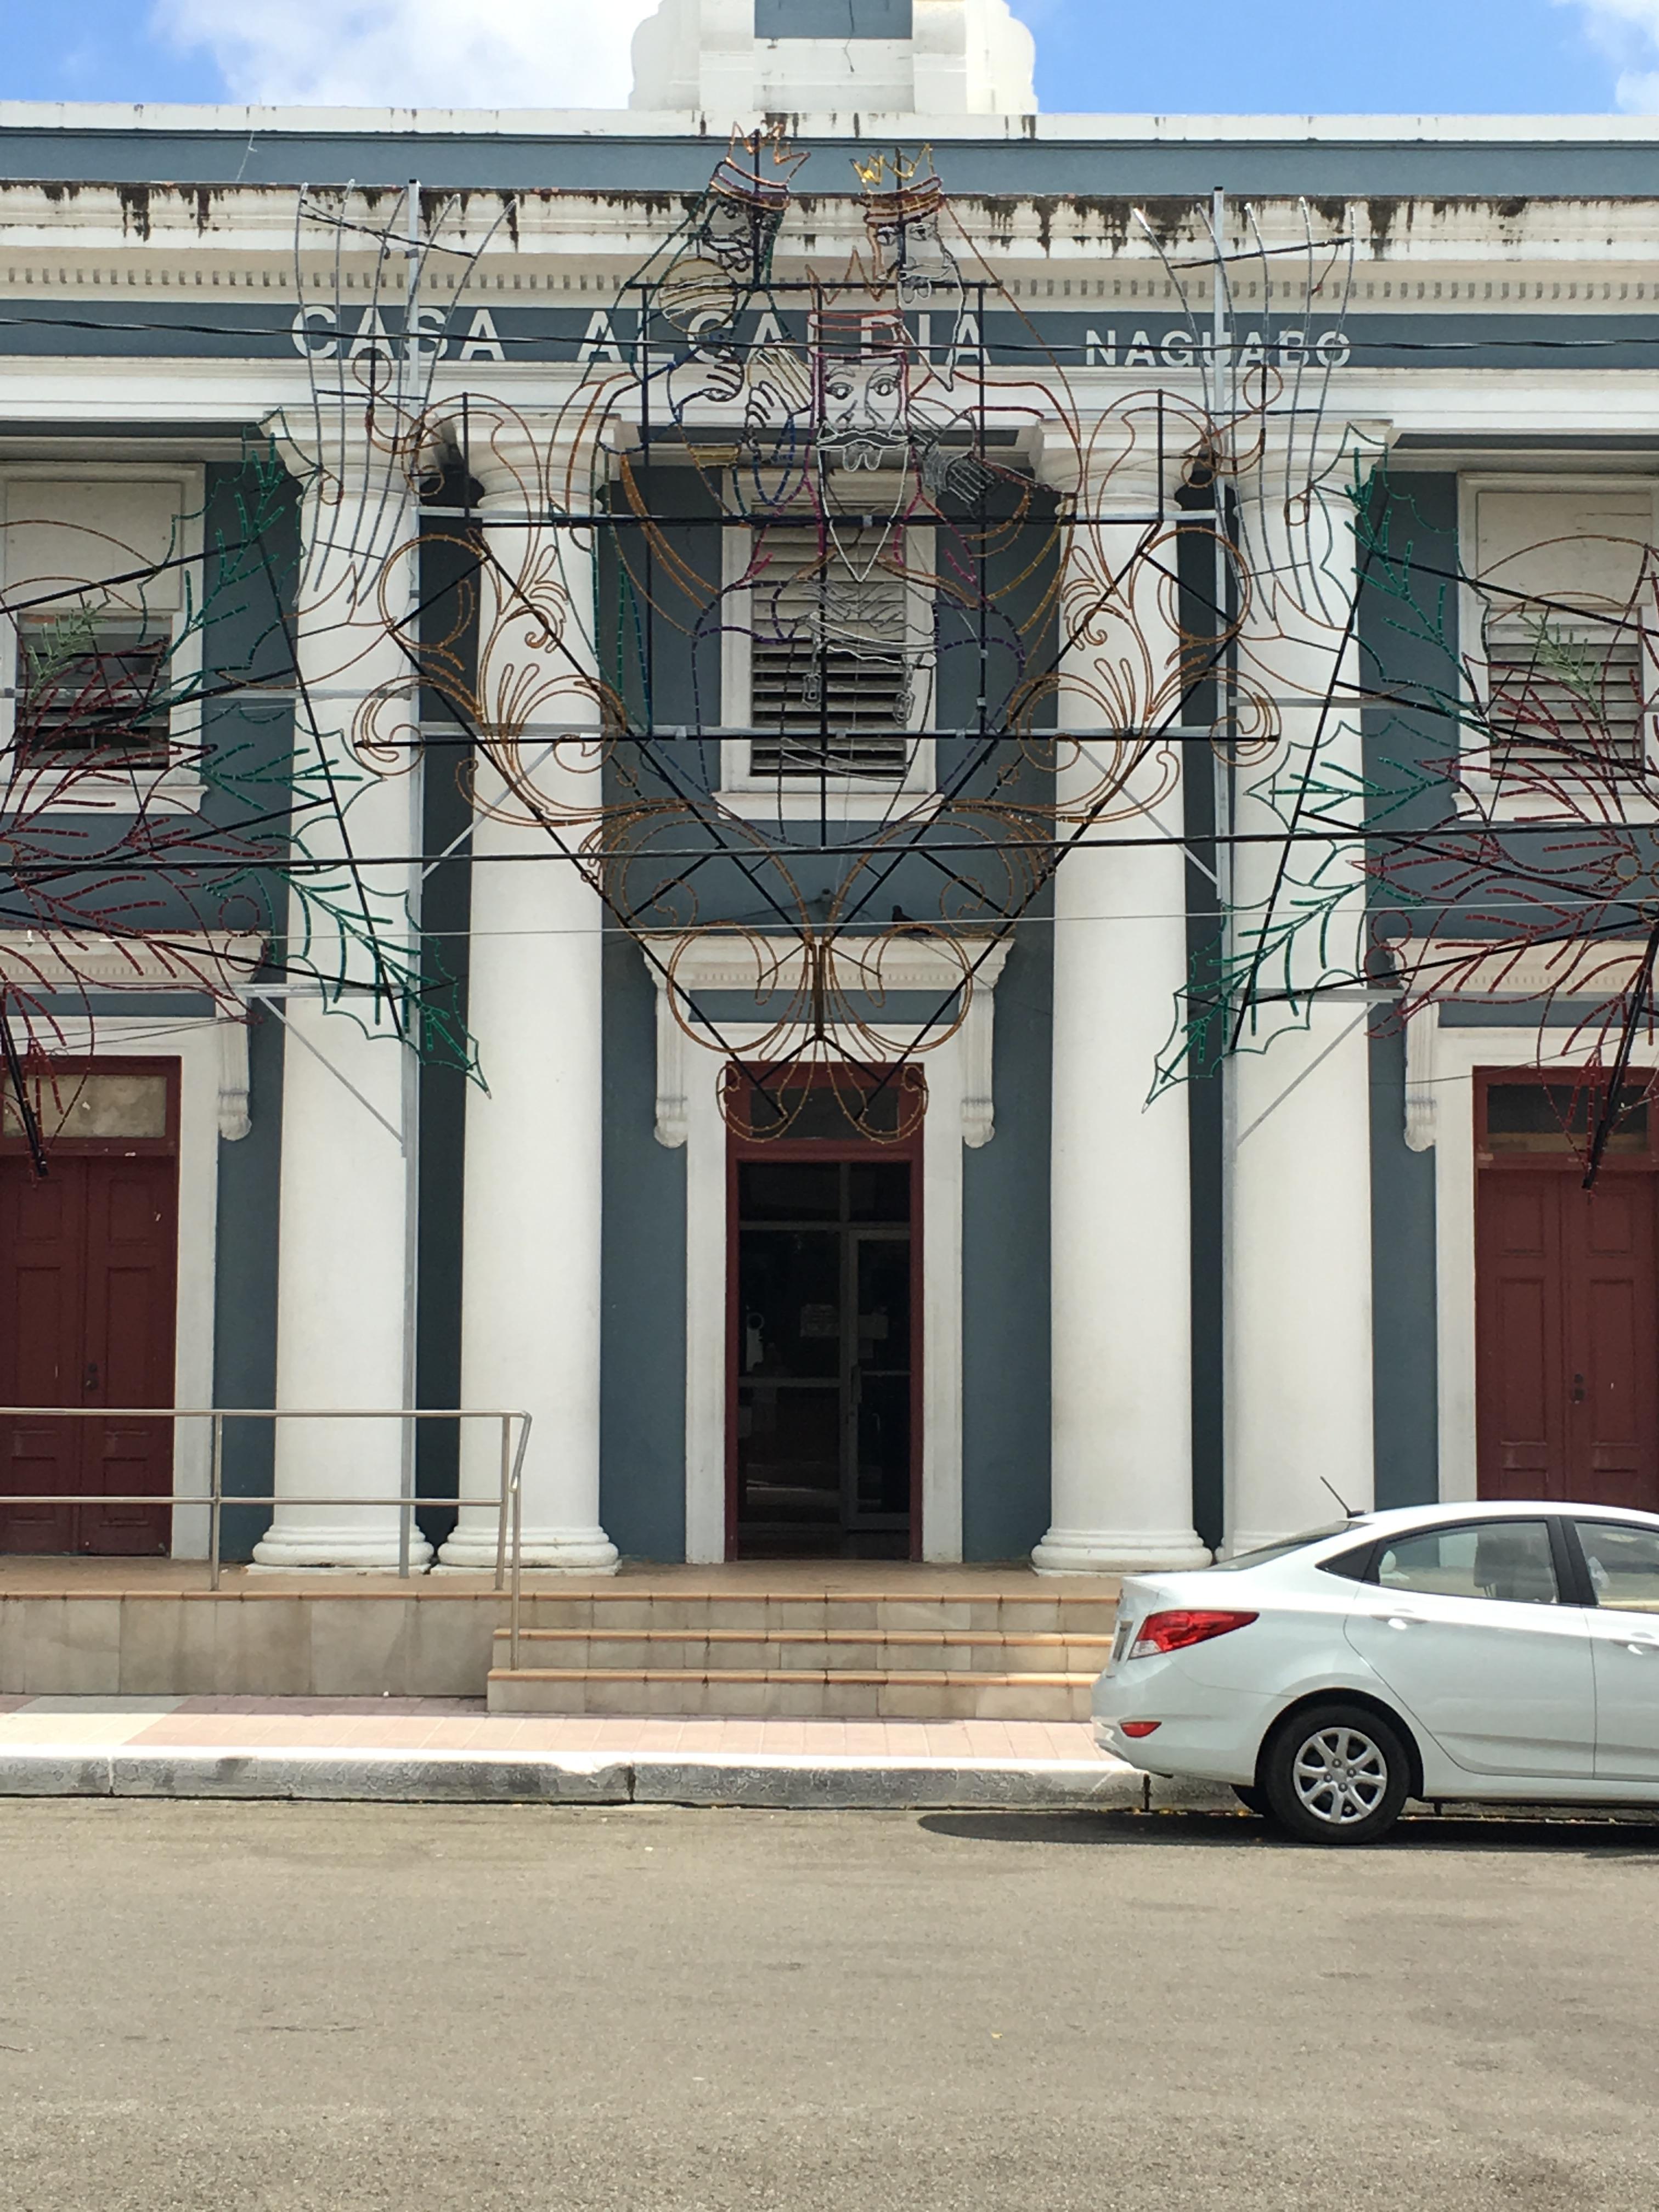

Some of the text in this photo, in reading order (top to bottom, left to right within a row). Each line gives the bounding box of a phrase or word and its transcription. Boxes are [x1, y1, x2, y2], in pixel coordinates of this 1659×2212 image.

[291, 305, 1351, 368] CASA ALCALDIA NAGUABO
